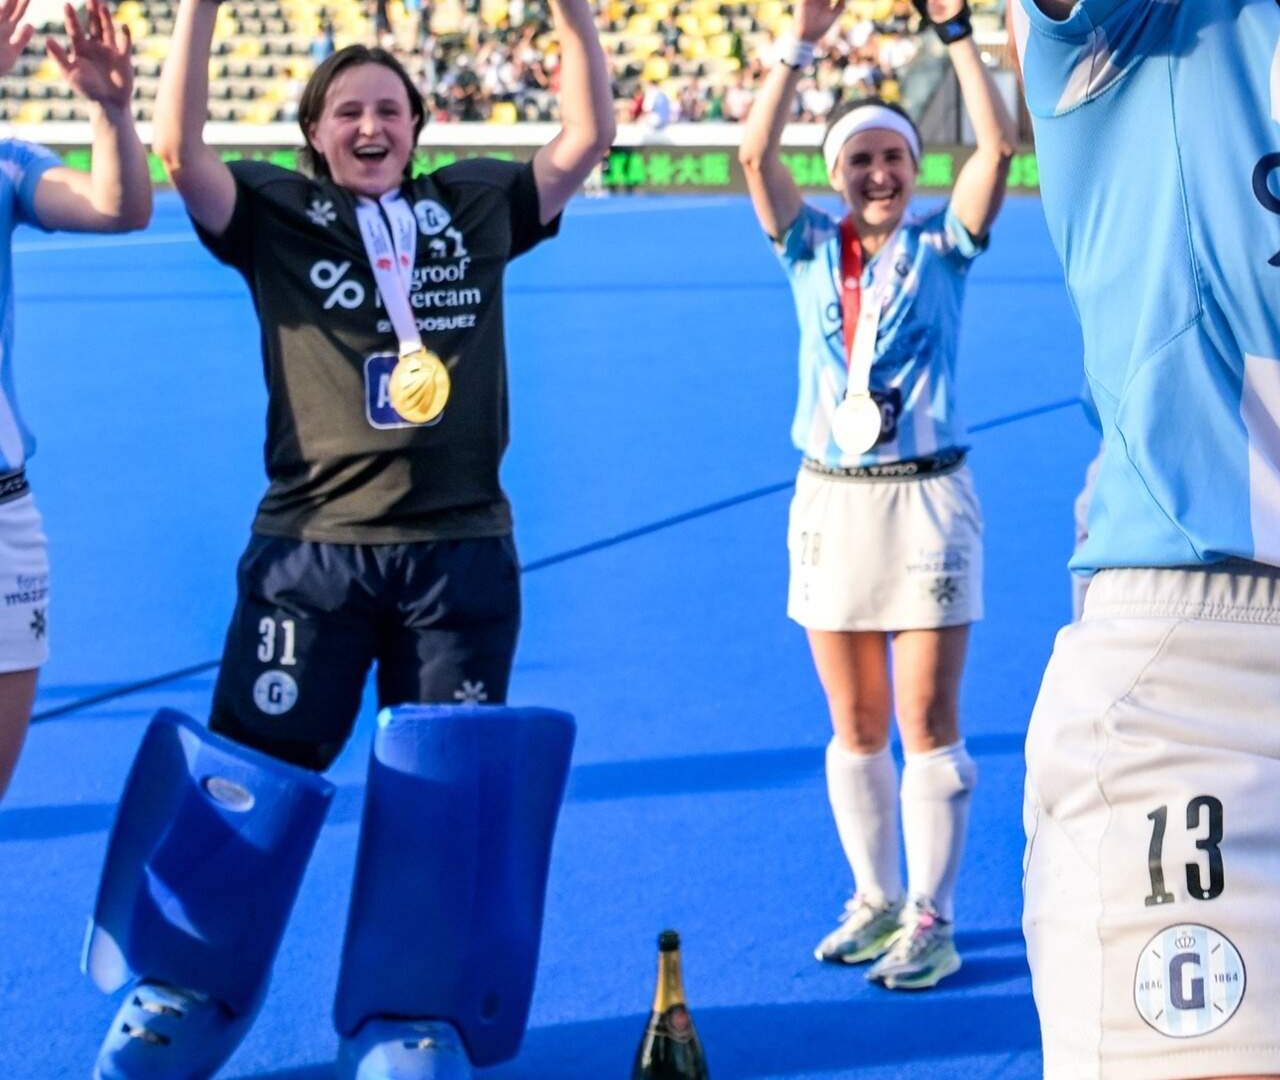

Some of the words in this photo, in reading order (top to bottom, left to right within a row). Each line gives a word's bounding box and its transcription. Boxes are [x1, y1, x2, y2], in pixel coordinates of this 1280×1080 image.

[257, 616, 298, 666] 31
[1144, 795, 1225, 907] 13
[1168, 951, 1206, 1011] G
[1213, 972, 1239, 985] 1864
